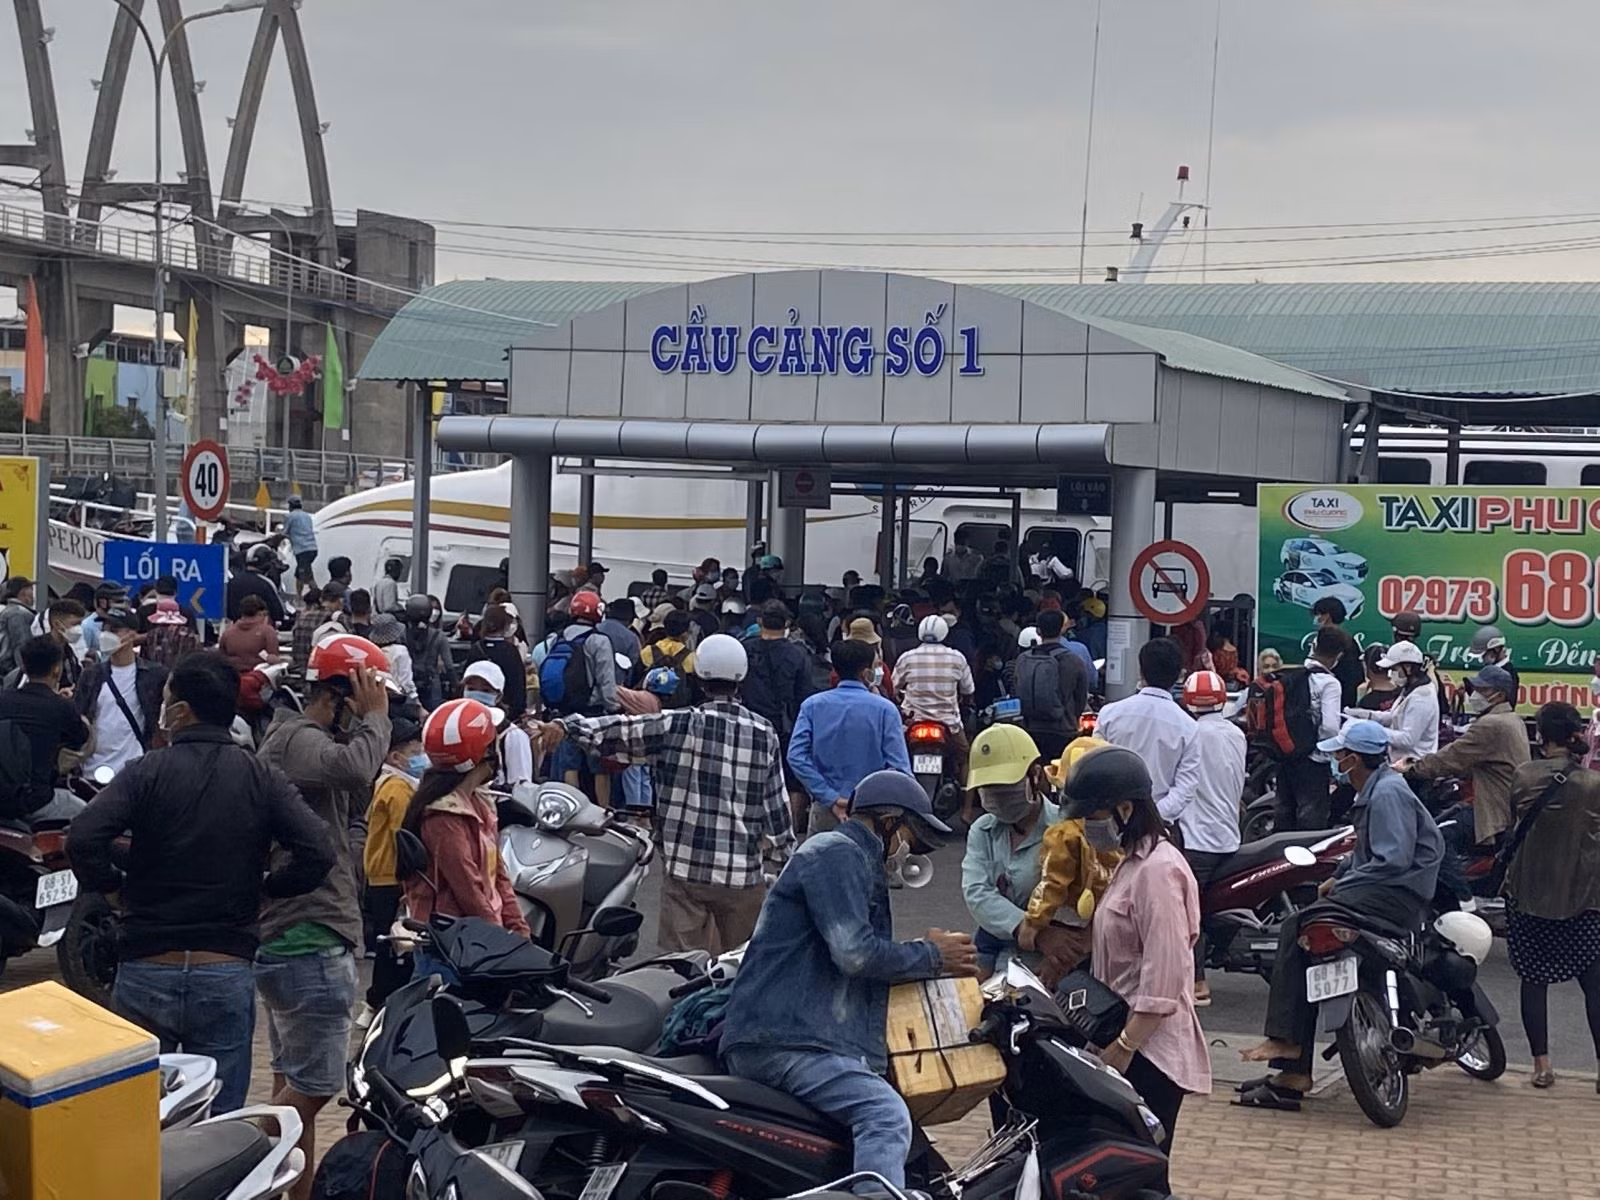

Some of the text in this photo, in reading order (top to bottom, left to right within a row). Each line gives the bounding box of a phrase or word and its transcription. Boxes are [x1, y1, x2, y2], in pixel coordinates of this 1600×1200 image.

[651, 303, 984, 376] CẦU CẢNG SỐ 1
[195, 462, 218, 497] 40
[1311, 498, 1339, 508] TAXI
[1377, 495, 1472, 531] TAXI
[123, 547, 202, 582] LỐI RA
[1380, 549, 1600, 625] 02973 68
[1314, 976, 1349, 998] 5077
